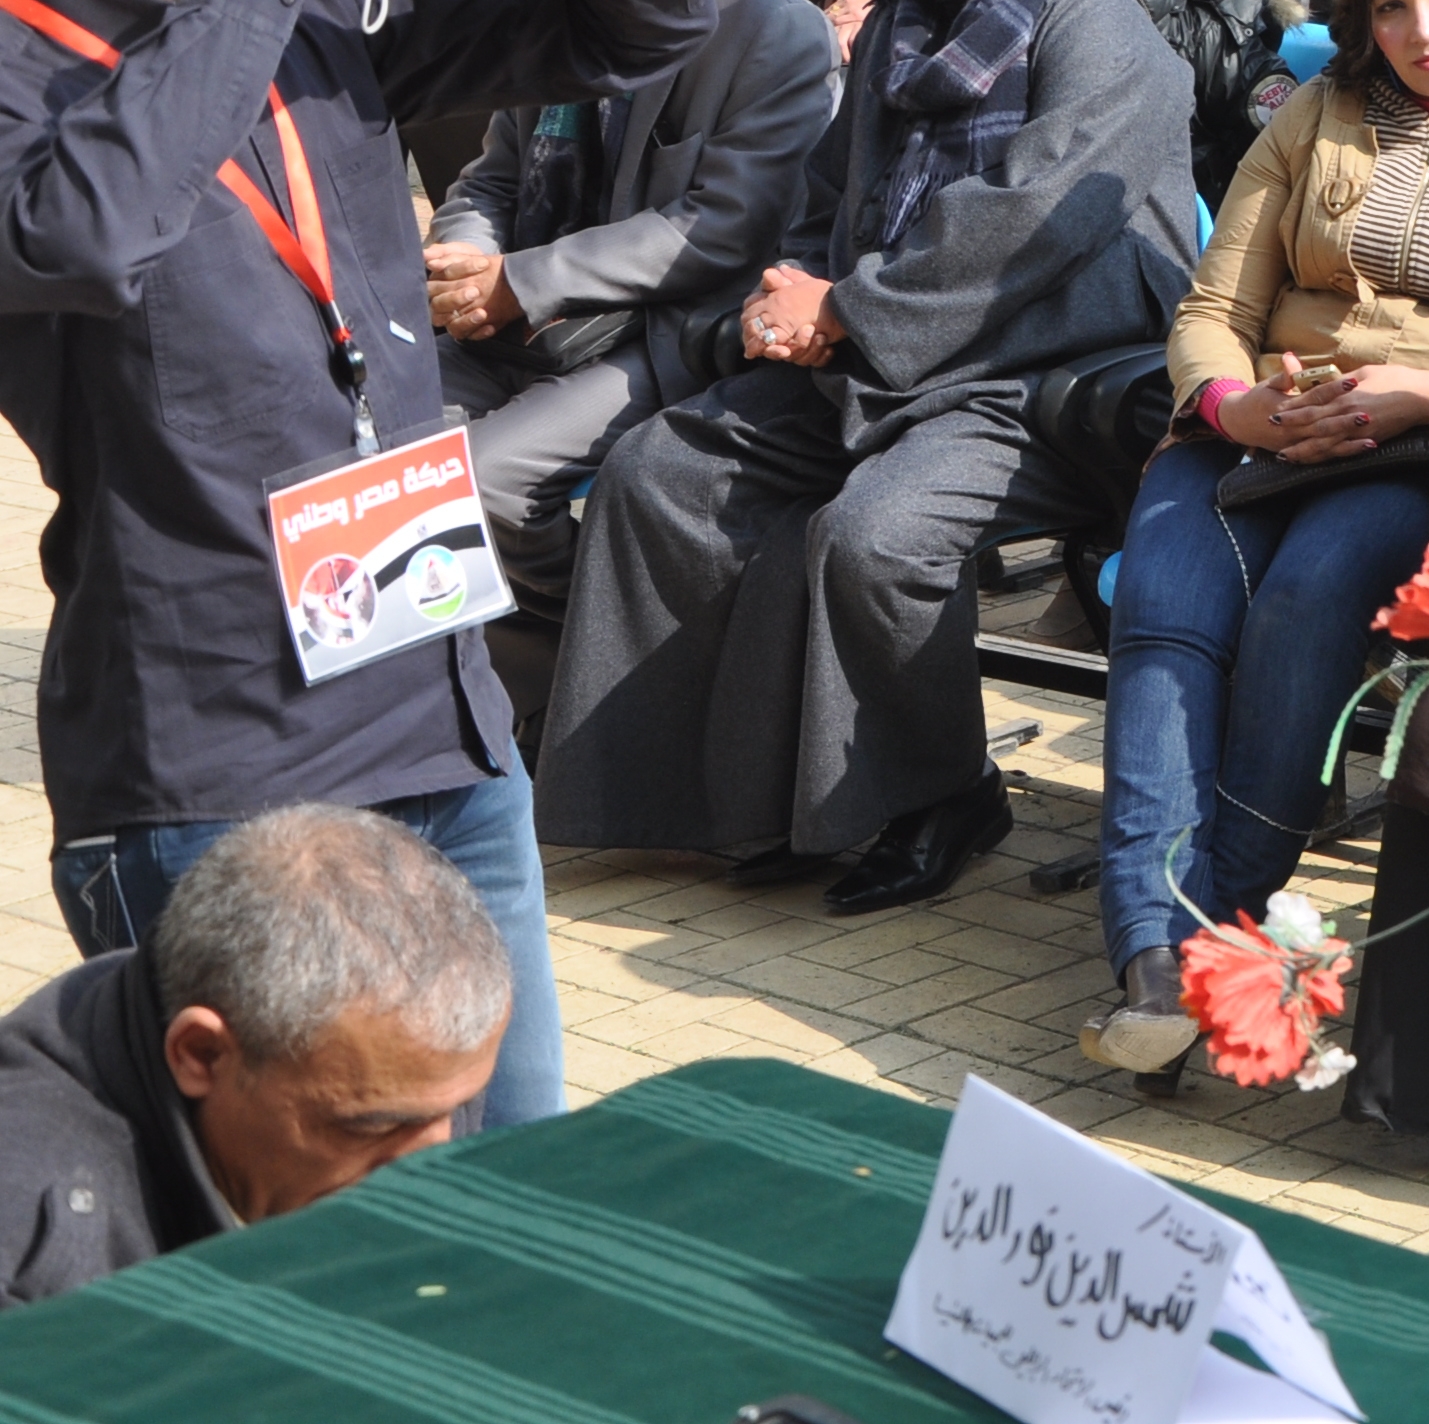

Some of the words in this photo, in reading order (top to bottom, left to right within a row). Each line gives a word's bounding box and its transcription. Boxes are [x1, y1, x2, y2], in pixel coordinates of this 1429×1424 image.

[353, 477, 401, 519] مصر
[403, 456, 465, 493] حركة
[281, 495, 350, 543] وطني
[943, 1178, 1013, 1251] الدين
[1004, 1206, 1058, 1286] نور
[1046, 1234, 1123, 1328] الدين
[1097, 1271, 1196, 1341] شمس
